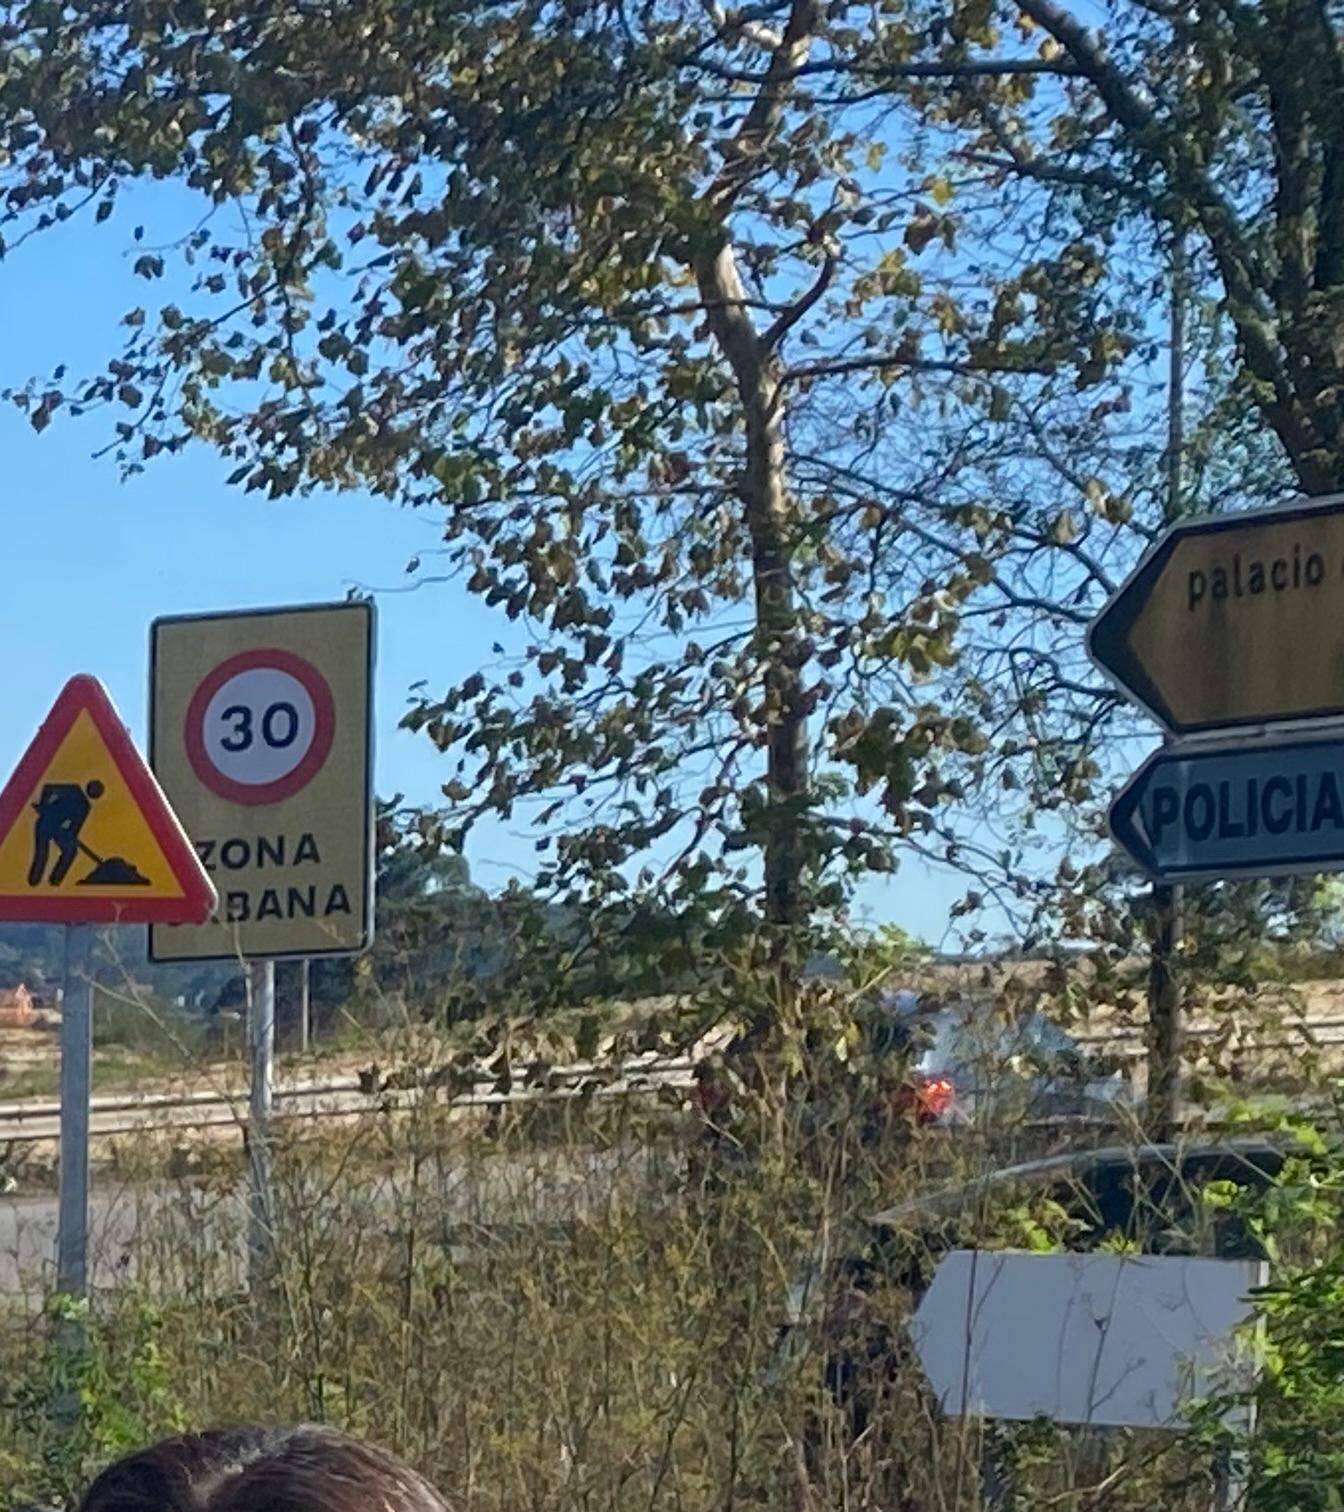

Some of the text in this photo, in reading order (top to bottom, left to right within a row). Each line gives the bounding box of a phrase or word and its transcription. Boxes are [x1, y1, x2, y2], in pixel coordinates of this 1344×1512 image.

[1187, 542, 1325, 613] palacio
[219, 701, 301, 754] 30
[1150, 770, 1344, 846] POLICIA
[193, 832, 322, 872] ZONA
[169, 883, 352, 927] BANA
